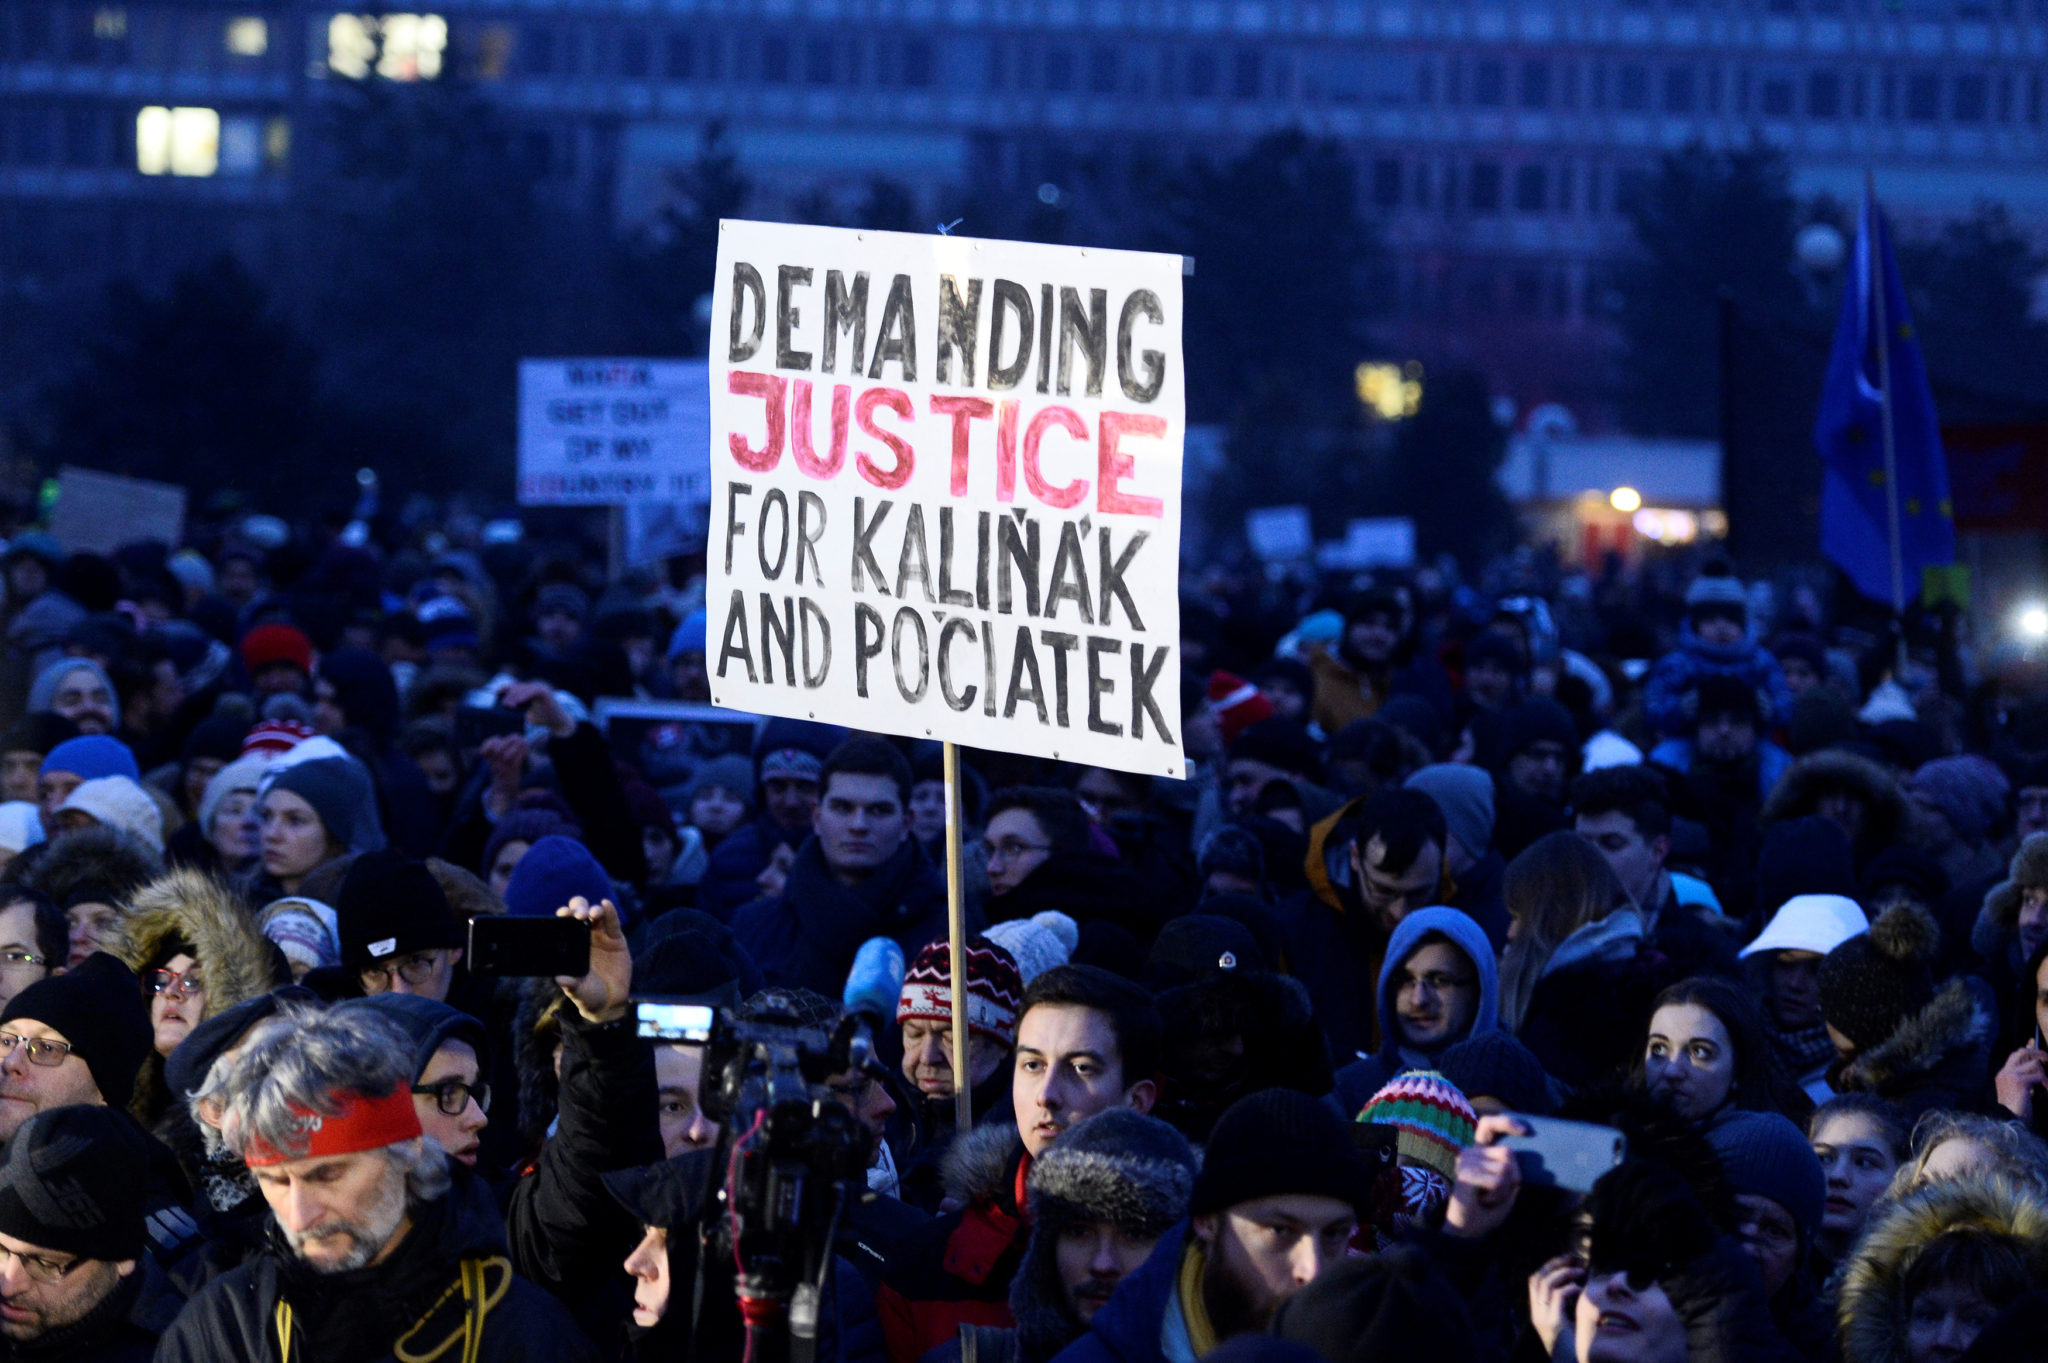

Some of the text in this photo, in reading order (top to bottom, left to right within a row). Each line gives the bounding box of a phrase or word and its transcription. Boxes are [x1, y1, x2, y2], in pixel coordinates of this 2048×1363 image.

[729, 262, 1166, 403] DEMANDING
[728, 370, 1168, 518] JUSTICE
[725, 481, 1150, 632] FOR KALIŇÁK
[717, 589, 1176, 745] AND POČIATEK
